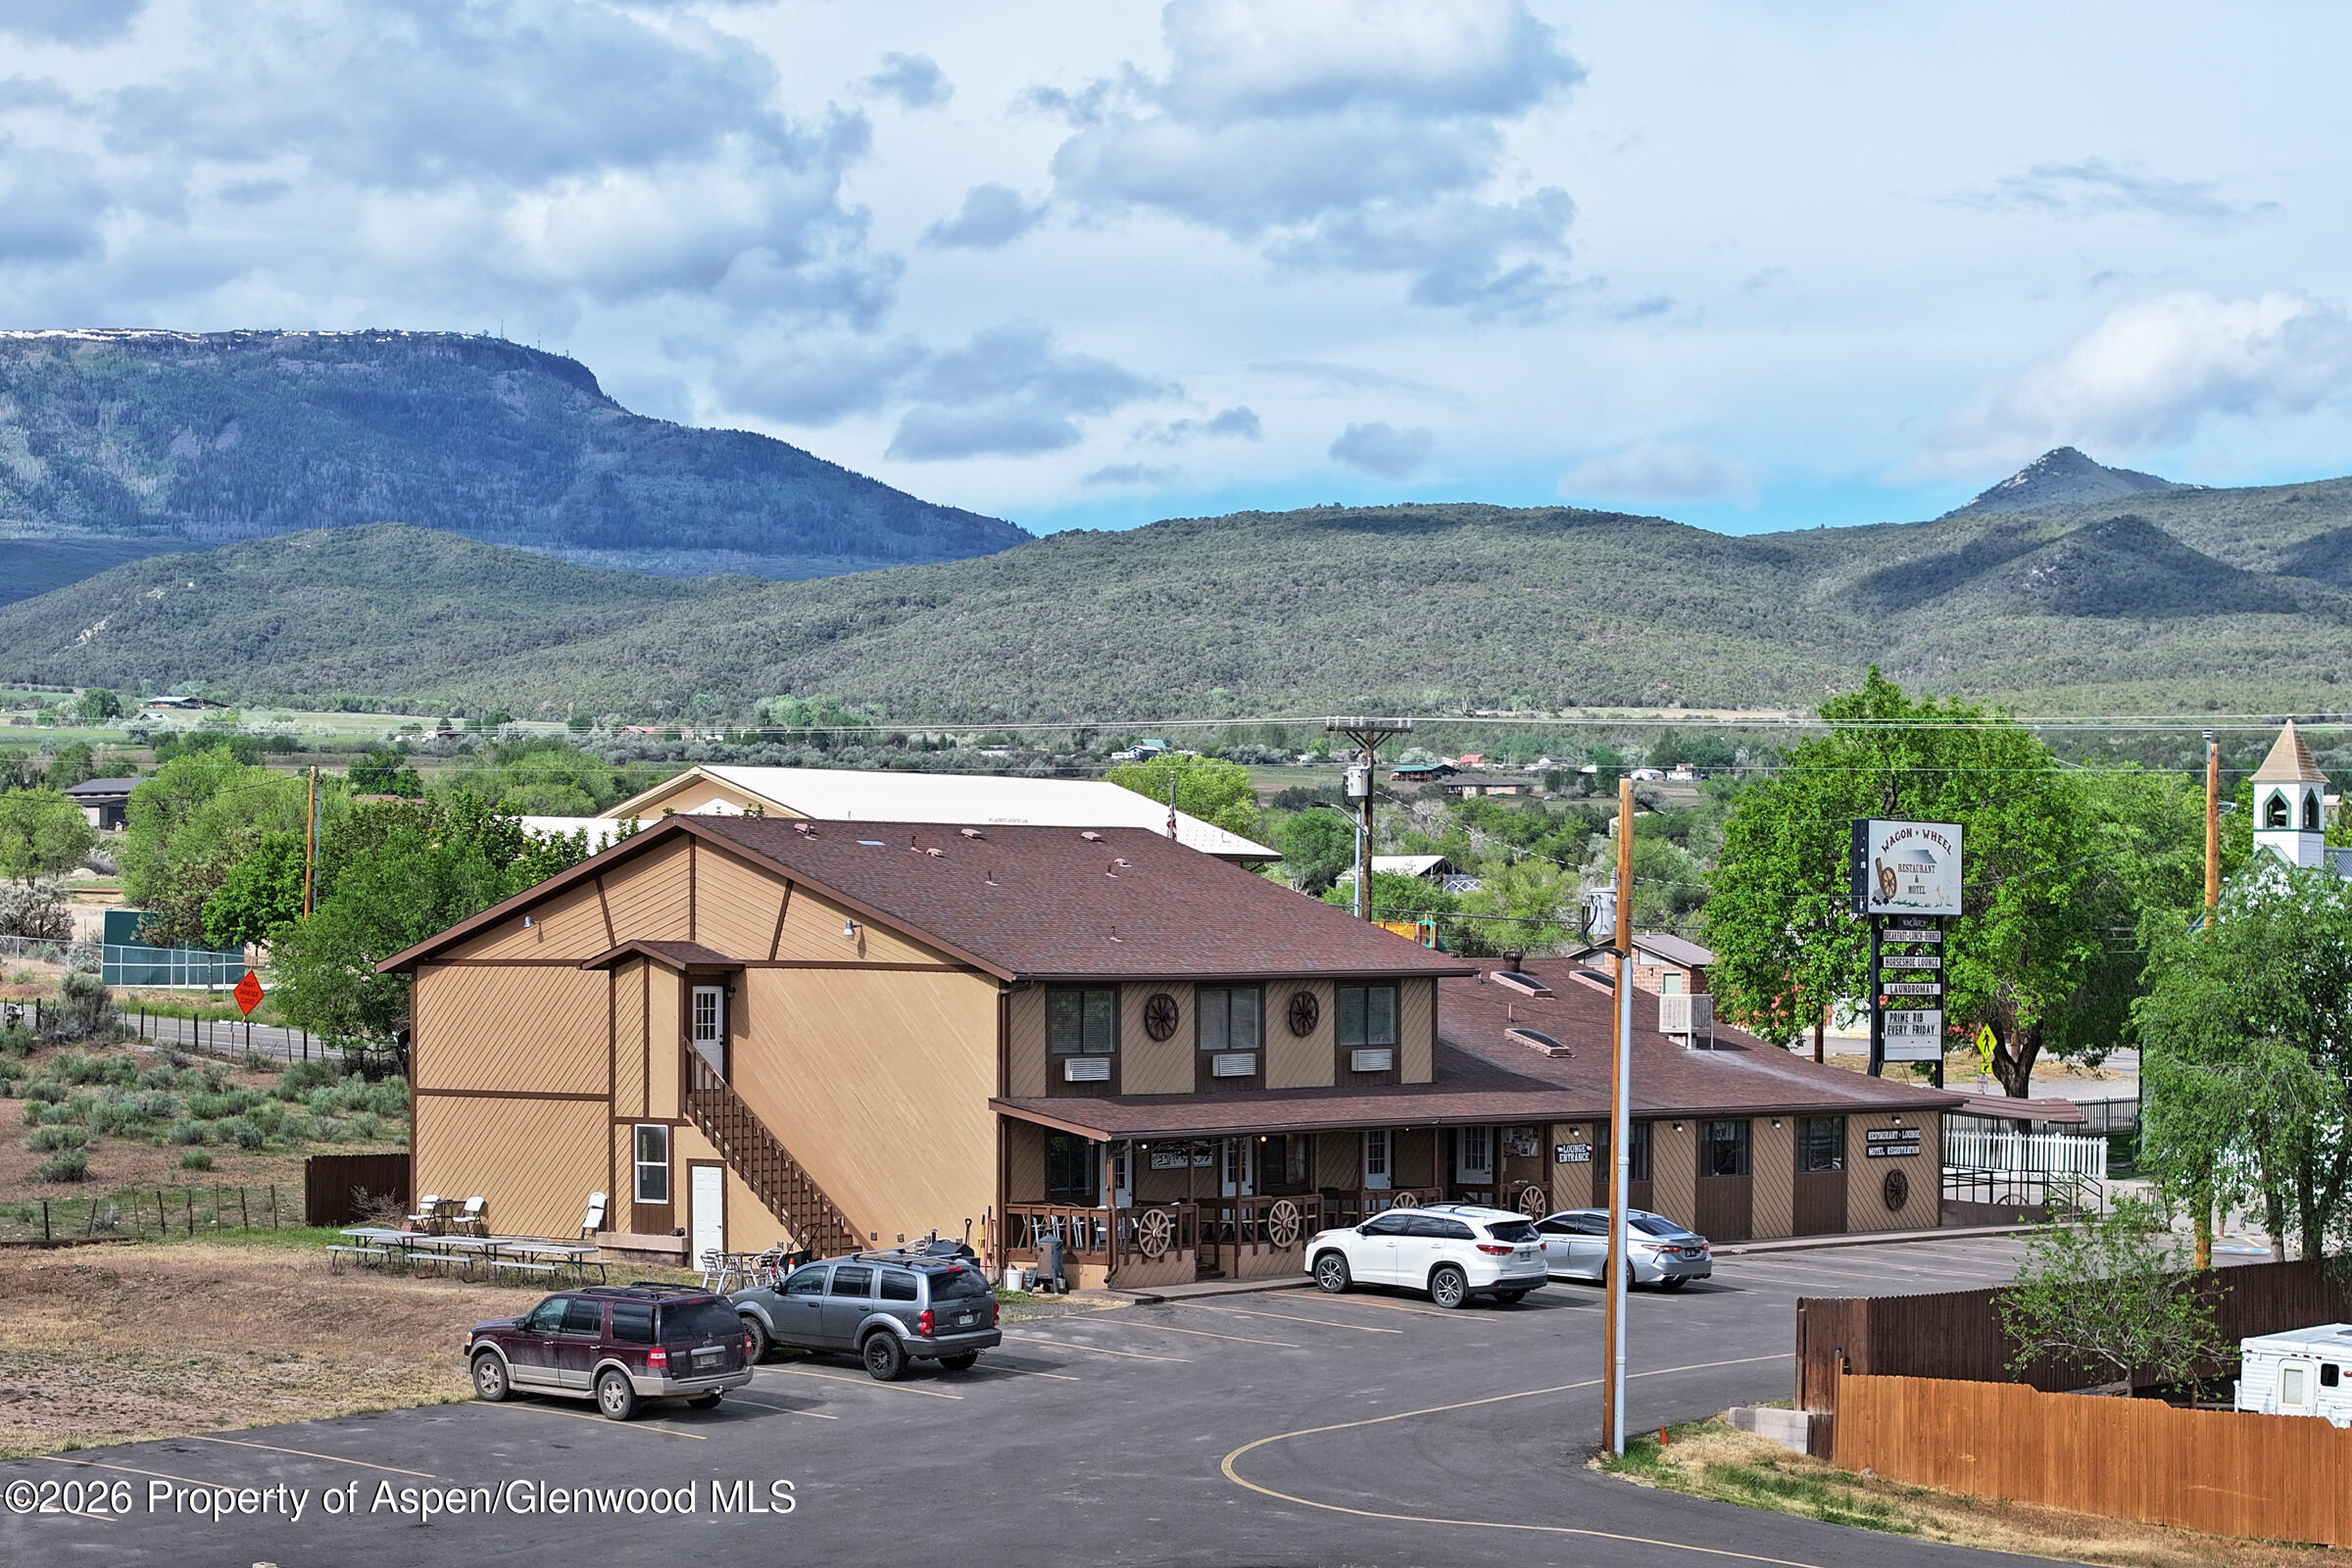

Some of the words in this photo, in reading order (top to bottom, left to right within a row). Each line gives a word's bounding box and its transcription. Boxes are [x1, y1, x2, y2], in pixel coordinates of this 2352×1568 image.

[1881, 828, 1913, 854] WAGON
[1922, 829, 1952, 856] WHEEL
[1897, 863, 1936, 874] RESTAURANT
[1914, 874, 1919, 883] &
[1908, 885, 1926, 895] MOTEL
[1886, 957, 1915, 967] HORSESHOE
[1918, 957, 1938, 967] LOUNGE
[1889, 984, 1935, 994] LAUNDROMAT
[1889, 1012, 1909, 1023] PRIME
[1913, 1012, 1924, 1022] RIB
[1887, 1025, 1907, 1036] EVERY
[1912, 1025, 1936, 1036] FRIDAY
[1563, 1144, 1587, 1152] LOUNGE
[1868, 1147, 1885, 1156] MOTEL
[1559, 1152, 1590, 1162] ENTRANCE
